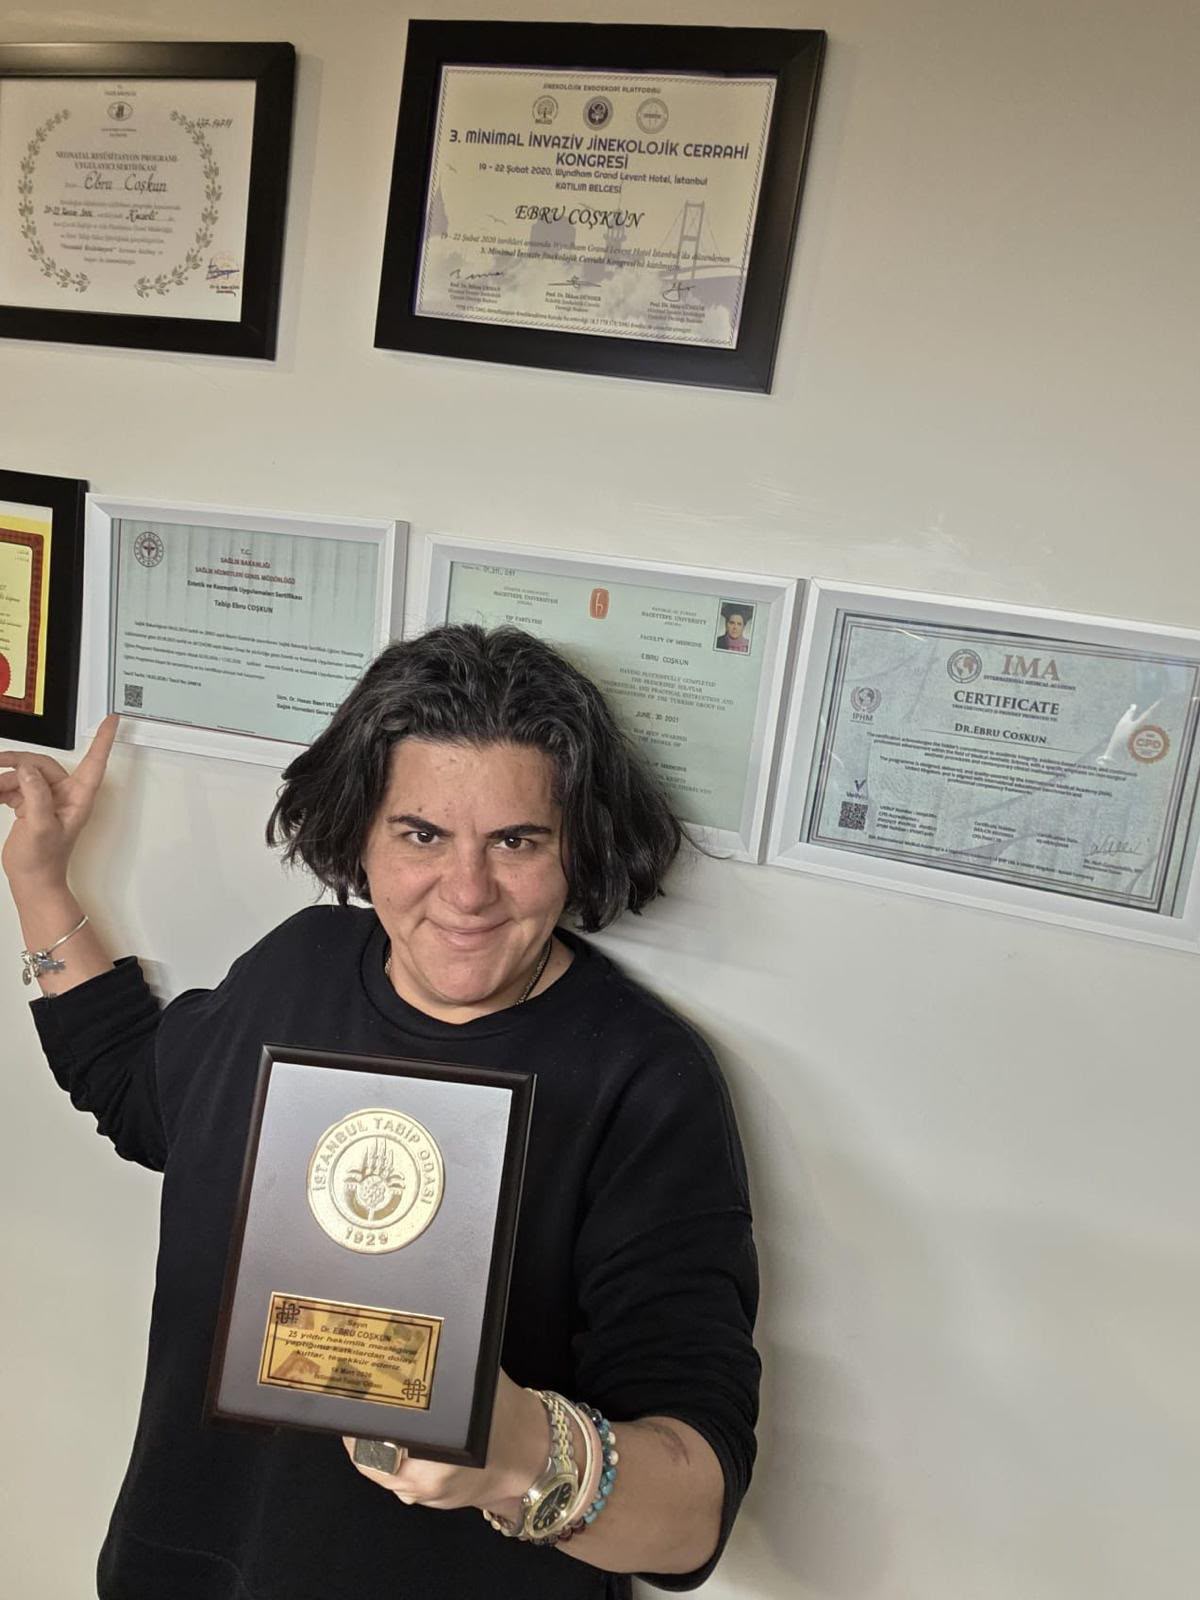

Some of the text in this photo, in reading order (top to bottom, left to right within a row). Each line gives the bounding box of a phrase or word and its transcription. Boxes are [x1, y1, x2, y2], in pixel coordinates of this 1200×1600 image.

[449, 128, 750, 160] 3. MİNİMAL İNVAZİV JİNEKOLOJİK CERRAHİ
[556, 151, 629, 169] KONGRESİ
[555, 168, 592, 180] Wyndham
[594, 171, 618, 180] Grand
[515, 204, 645, 230] EBRU COŞKUN
[1001, 654, 1061, 681] IMA
[953, 689, 1060, 716] CERTIFICATE
[288, 1330, 298, 1338] 25
[332, 1327, 355, 1338] EBRU
